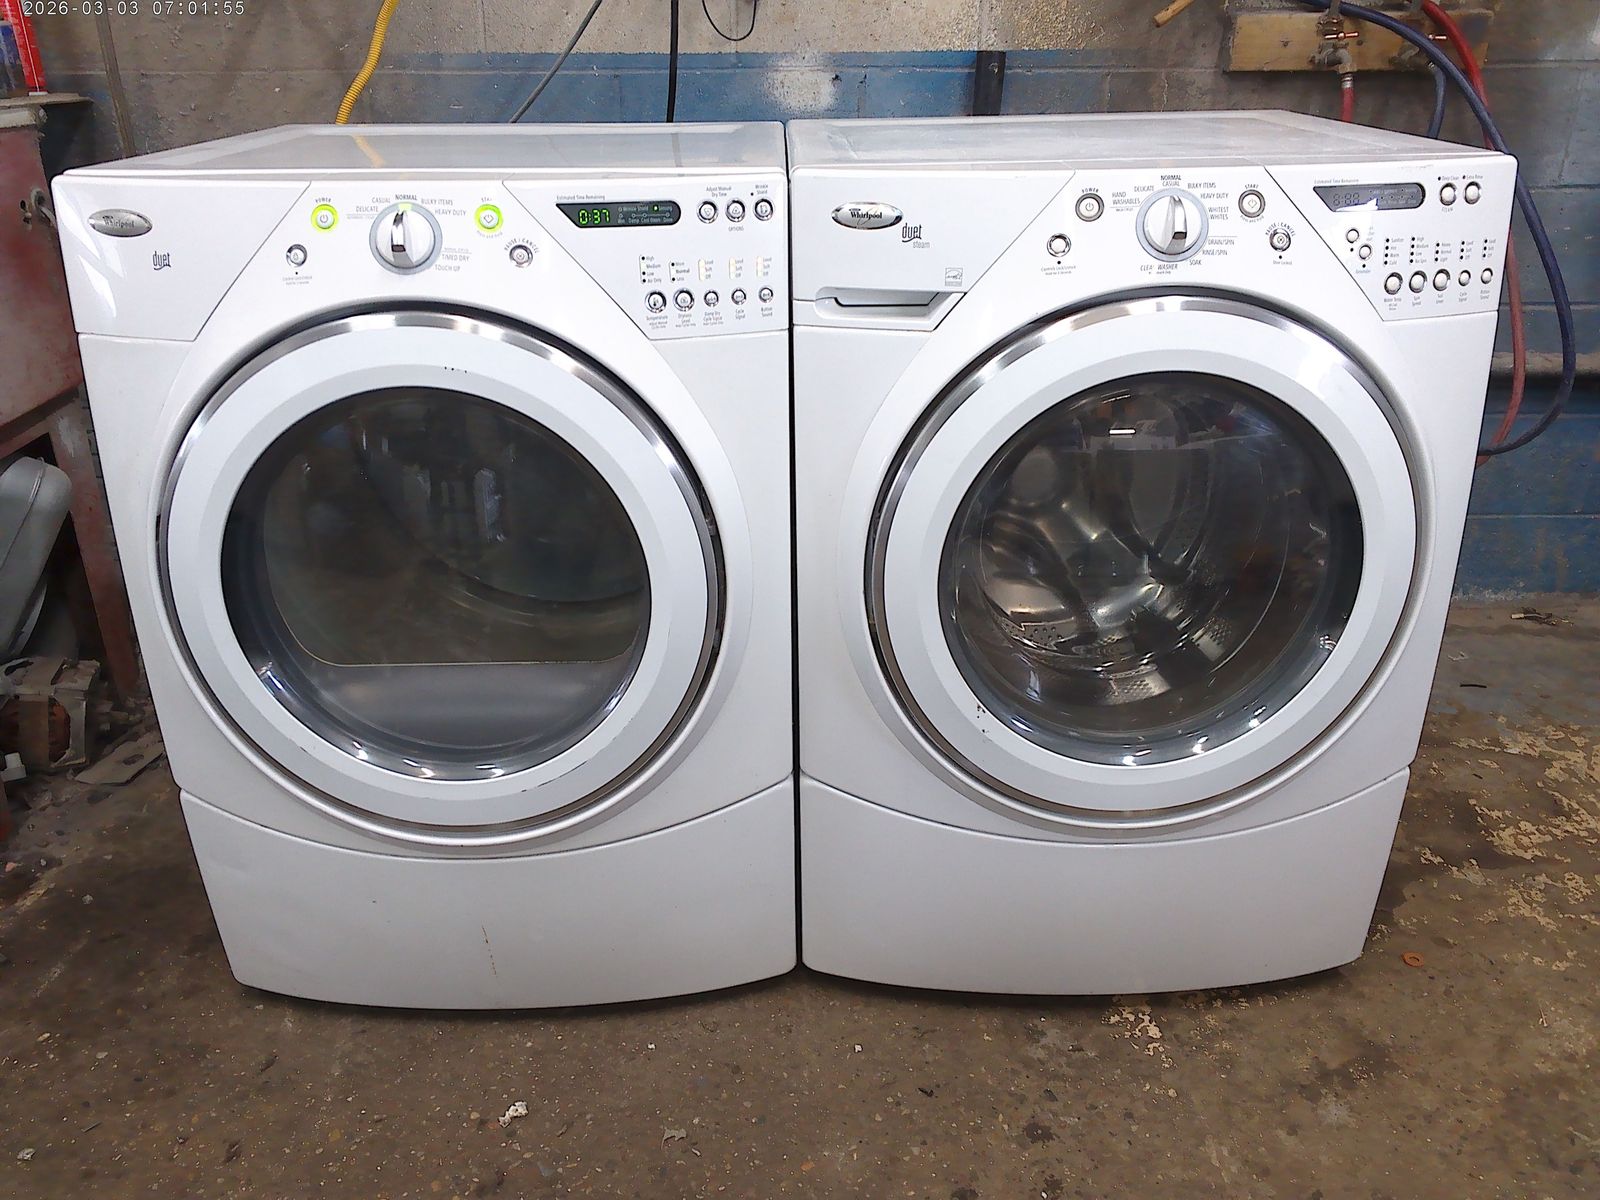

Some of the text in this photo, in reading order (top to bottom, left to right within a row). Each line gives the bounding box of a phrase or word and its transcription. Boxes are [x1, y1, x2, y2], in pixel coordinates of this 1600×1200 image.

[1134, 185, 1154, 193] DELICATE
[435, 208, 451, 216] HEAVY
[579, 209, 610, 224] 0:37
[850, 211, 882, 220] Whirlpool
[104, 219, 135, 228] Whirlpool
[1265, 222, 1278, 236] PAUSE
[1280, 222, 1296, 237] CANCEL
[901, 222, 922, 242] duet
[504, 238, 517, 251] PAUSE
[521, 238, 540, 254] CANCEL
[152, 250, 171, 270] duet
[442, 253, 458, 261] TIMED
